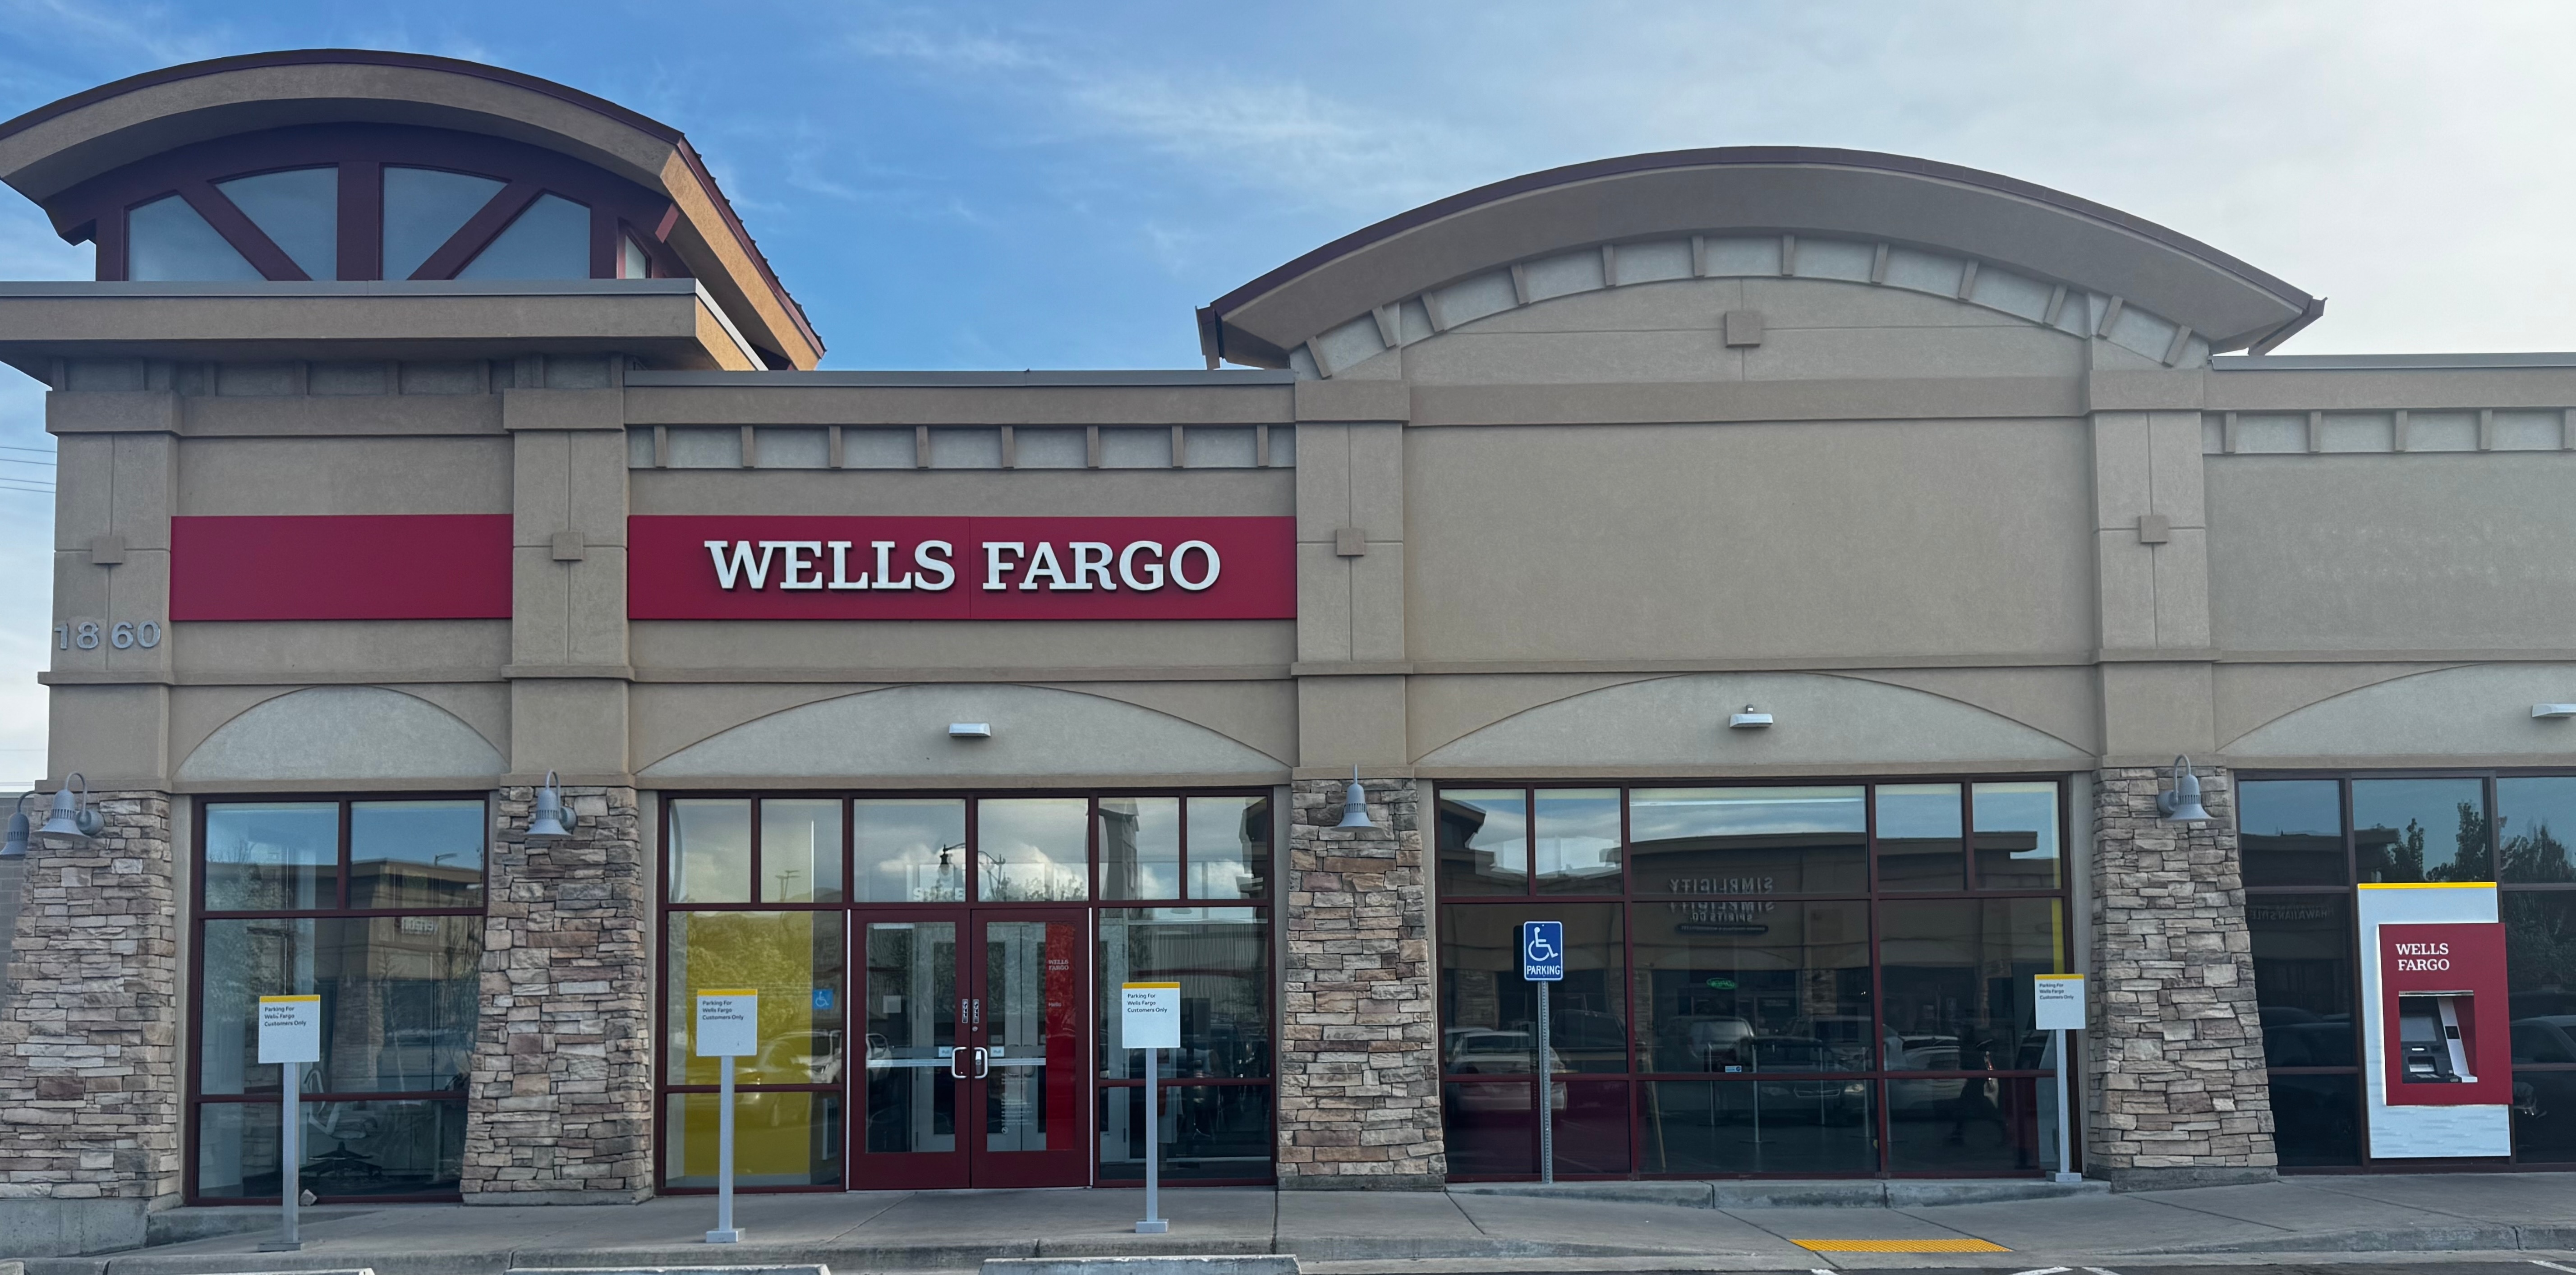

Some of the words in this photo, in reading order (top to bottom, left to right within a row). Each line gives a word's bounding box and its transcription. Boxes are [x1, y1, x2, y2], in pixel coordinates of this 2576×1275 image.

[704, 540, 956, 591] WELLS
[982, 540, 1220, 591] FARGO
[54, 620, 161, 650] 1860
[2395, 943, 2449, 955] WELLS
[1527, 965, 1560, 975] PARKING
[2397, 958, 2450, 971] FARGO
